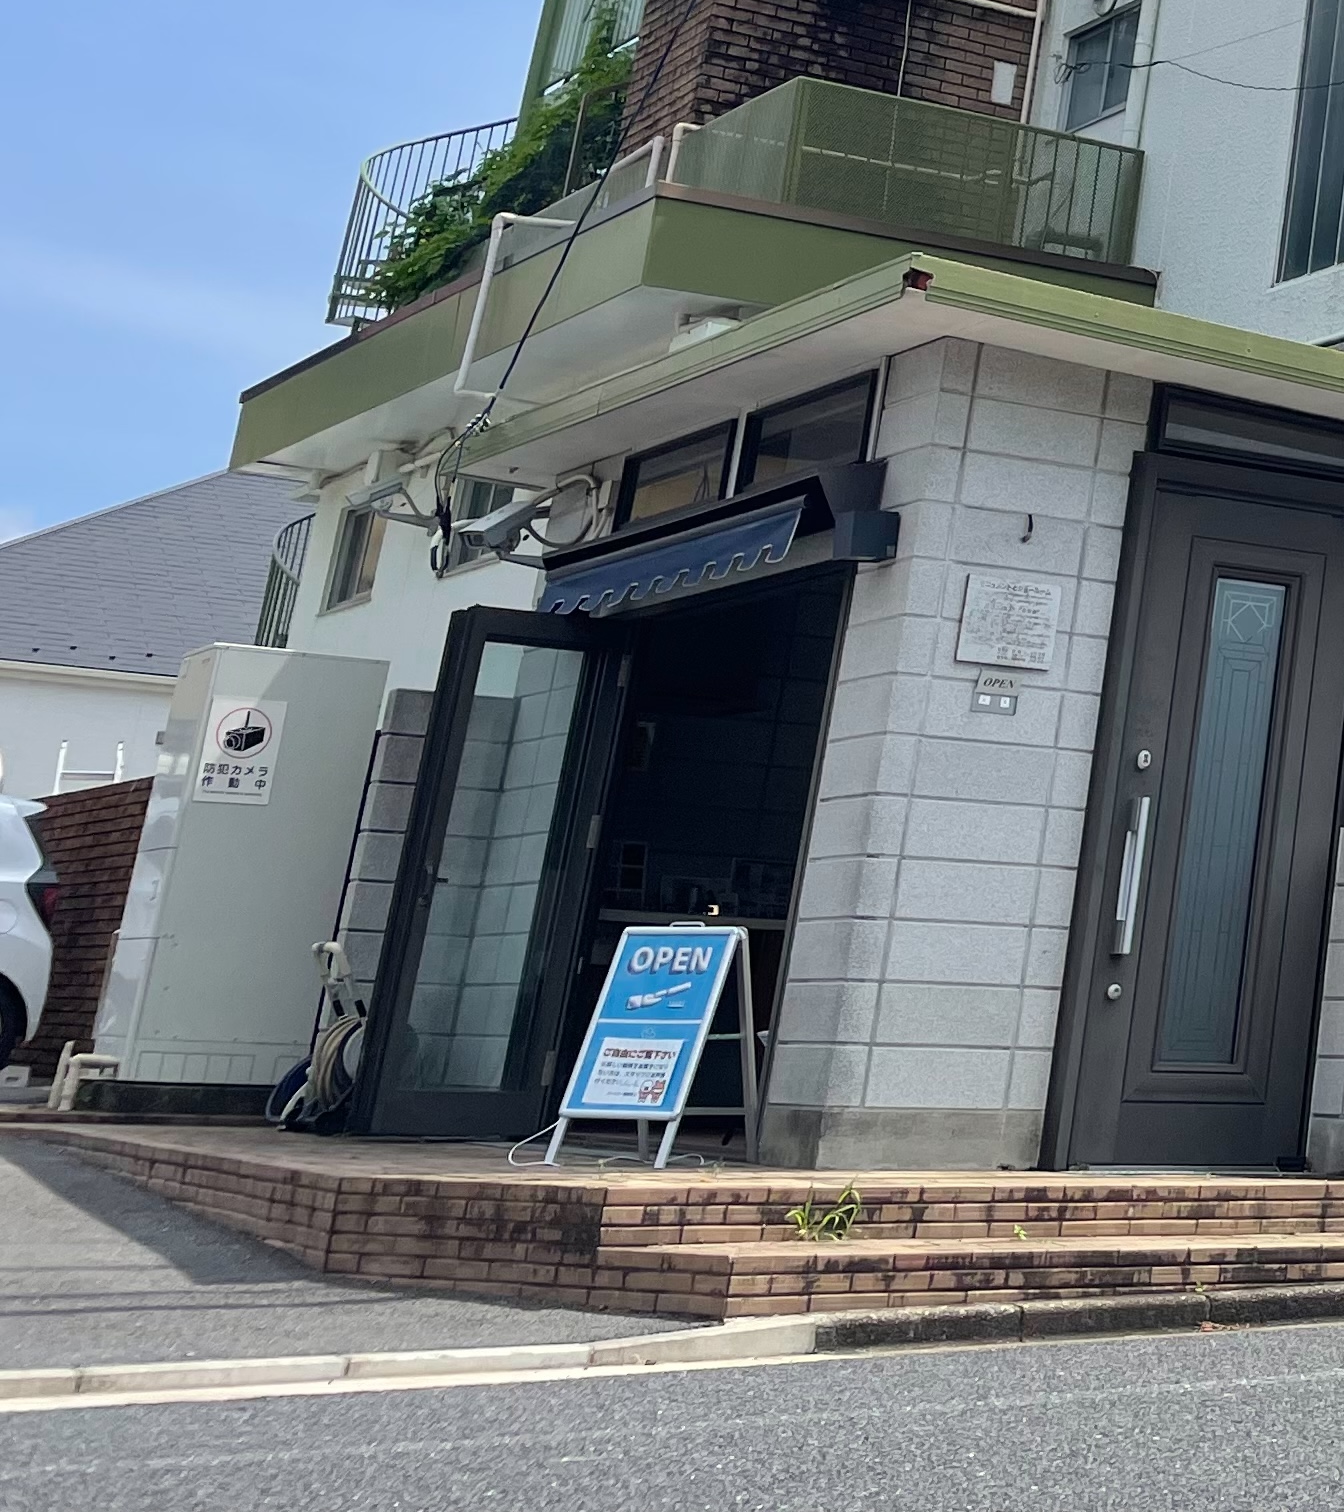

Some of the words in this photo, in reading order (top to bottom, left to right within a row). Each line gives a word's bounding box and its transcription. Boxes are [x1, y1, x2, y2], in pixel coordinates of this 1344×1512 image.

[984, 677, 1015, 689] OPEN
[203, 762, 269, 777] 防犯カメラ
[627, 946, 713, 975] OPEN
